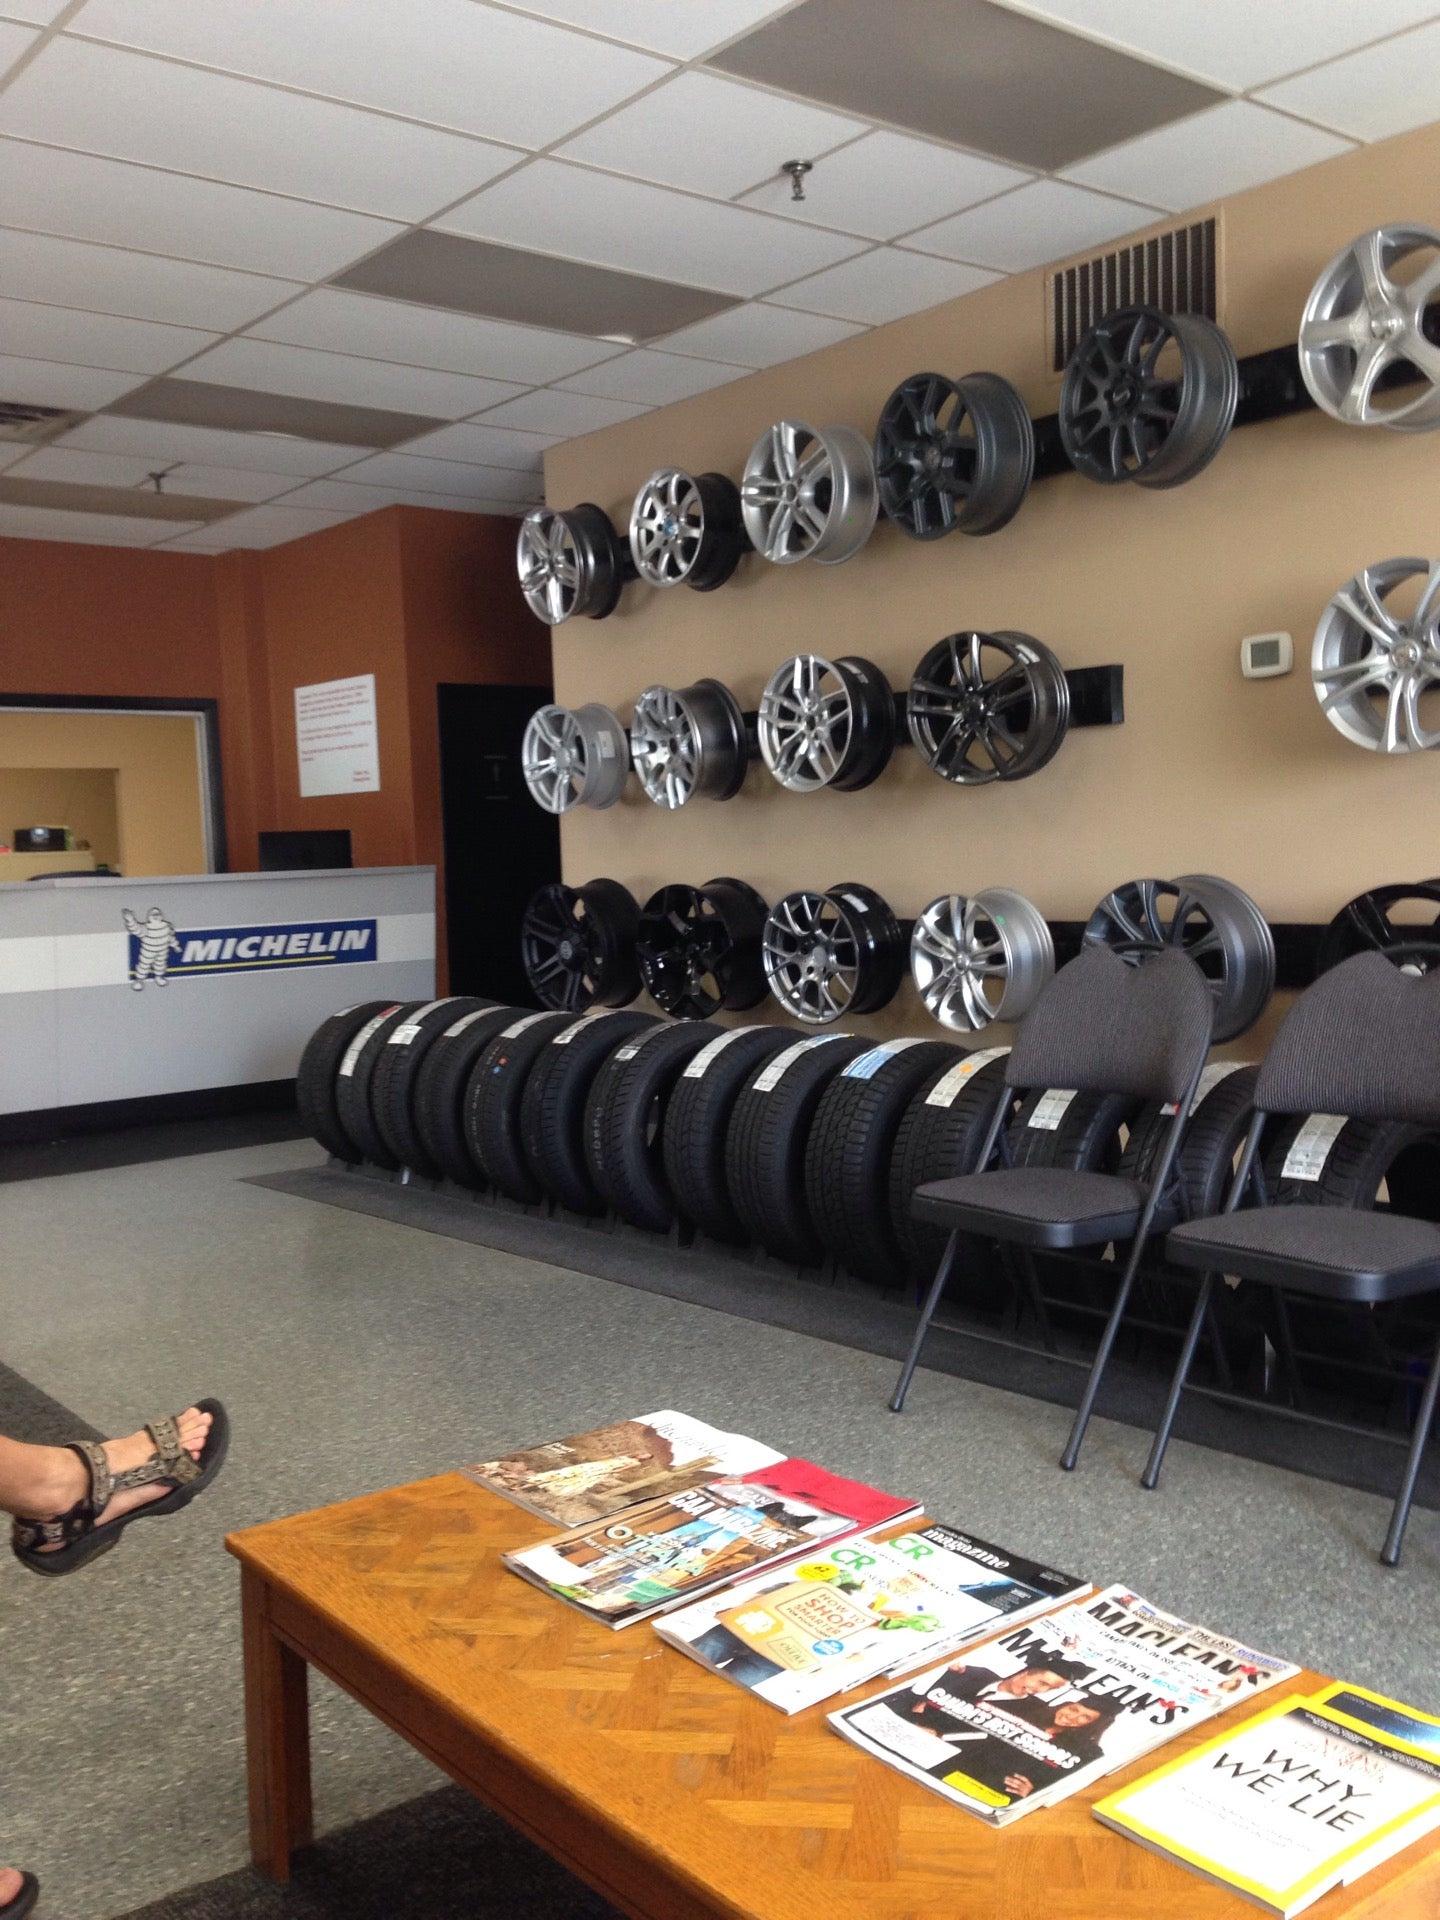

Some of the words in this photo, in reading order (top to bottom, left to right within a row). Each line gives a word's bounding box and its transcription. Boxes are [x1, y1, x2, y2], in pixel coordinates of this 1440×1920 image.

[181, 929, 371, 963] MICHELIN
[830, 1549, 876, 1571] CR
[889, 1537, 934, 1560] CR
[922, 1529, 1010, 1569] magazine
[805, 1598, 856, 1629] SHOP
[819, 1593, 848, 1613] HOW
[998, 1627, 1190, 1725] MAEAN'S
[1213, 1753, 1285, 1795] WE
[1288, 1794, 1366, 1832] LIE
[1263, 1749, 1372, 1803] WHY
